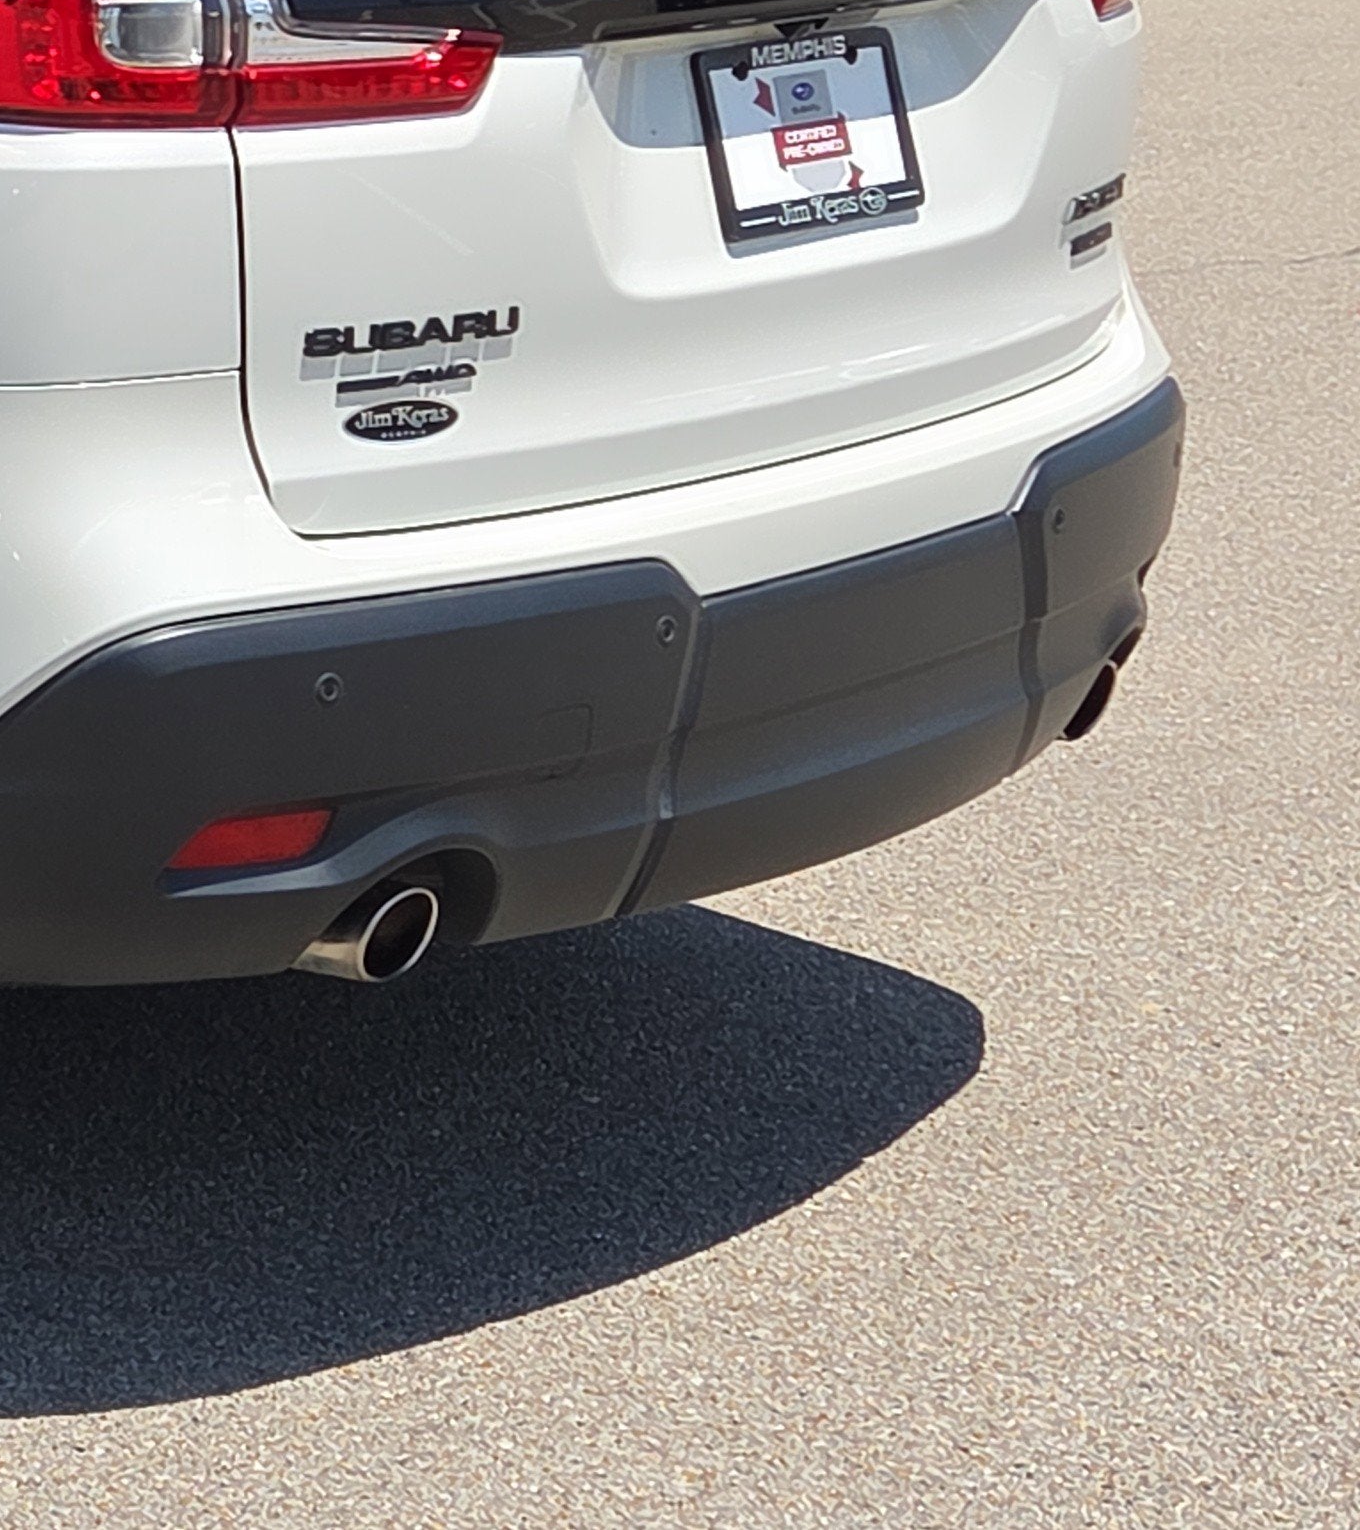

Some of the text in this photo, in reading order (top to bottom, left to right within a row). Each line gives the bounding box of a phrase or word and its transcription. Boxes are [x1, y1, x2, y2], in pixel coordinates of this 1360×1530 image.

[751, 34, 847, 67] MEMPHIS
[777, 203, 812, 227] Jim
[303, 306, 519, 356] SUBARU
[399, 363, 476, 385] AWD
[354, 405, 450, 430] Jim Keras
